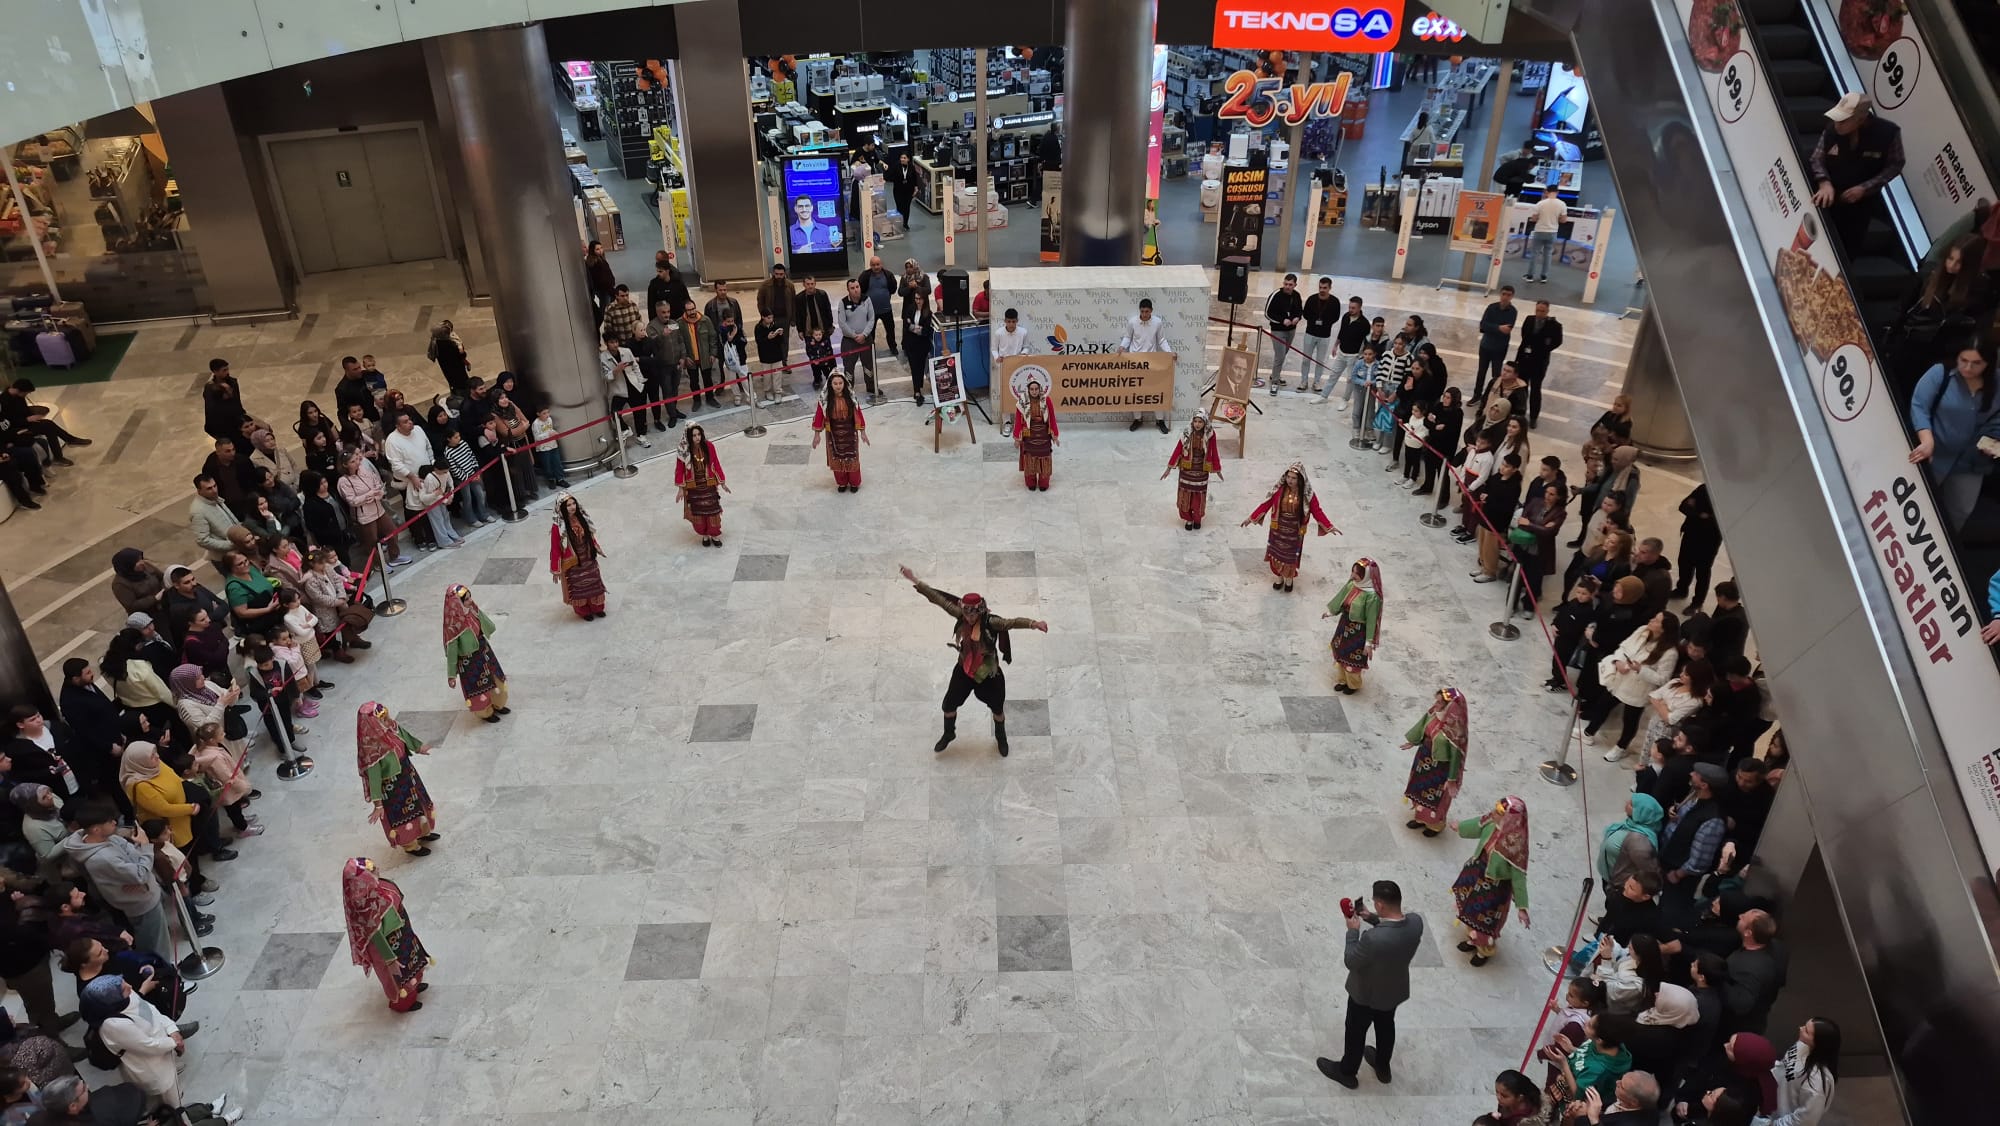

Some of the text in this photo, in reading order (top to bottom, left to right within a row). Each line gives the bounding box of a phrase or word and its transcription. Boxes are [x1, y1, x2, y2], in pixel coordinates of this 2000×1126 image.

[1224, 11, 1389, 34] TEKNOSA
[1227, 170, 1265, 184] KASIM
[1768, 168, 1789, 219] menüm
[1774, 156, 1802, 213] patatesli
[1935, 153, 1960, 204] menüm
[1942, 142, 1976, 198] patatesli
[1061, 375, 1144, 388] CUMHURİYET
[1062, 360, 1149, 371] AFYONKARAHİSAR
[1061, 395, 1121, 406] ANADOLU
[1125, 392, 1164, 405] LİSESİ
[1863, 489, 1953, 665] fırsatlar
[1892, 476, 1973, 638] doyuran
[1982, 754, 2000, 799] men
